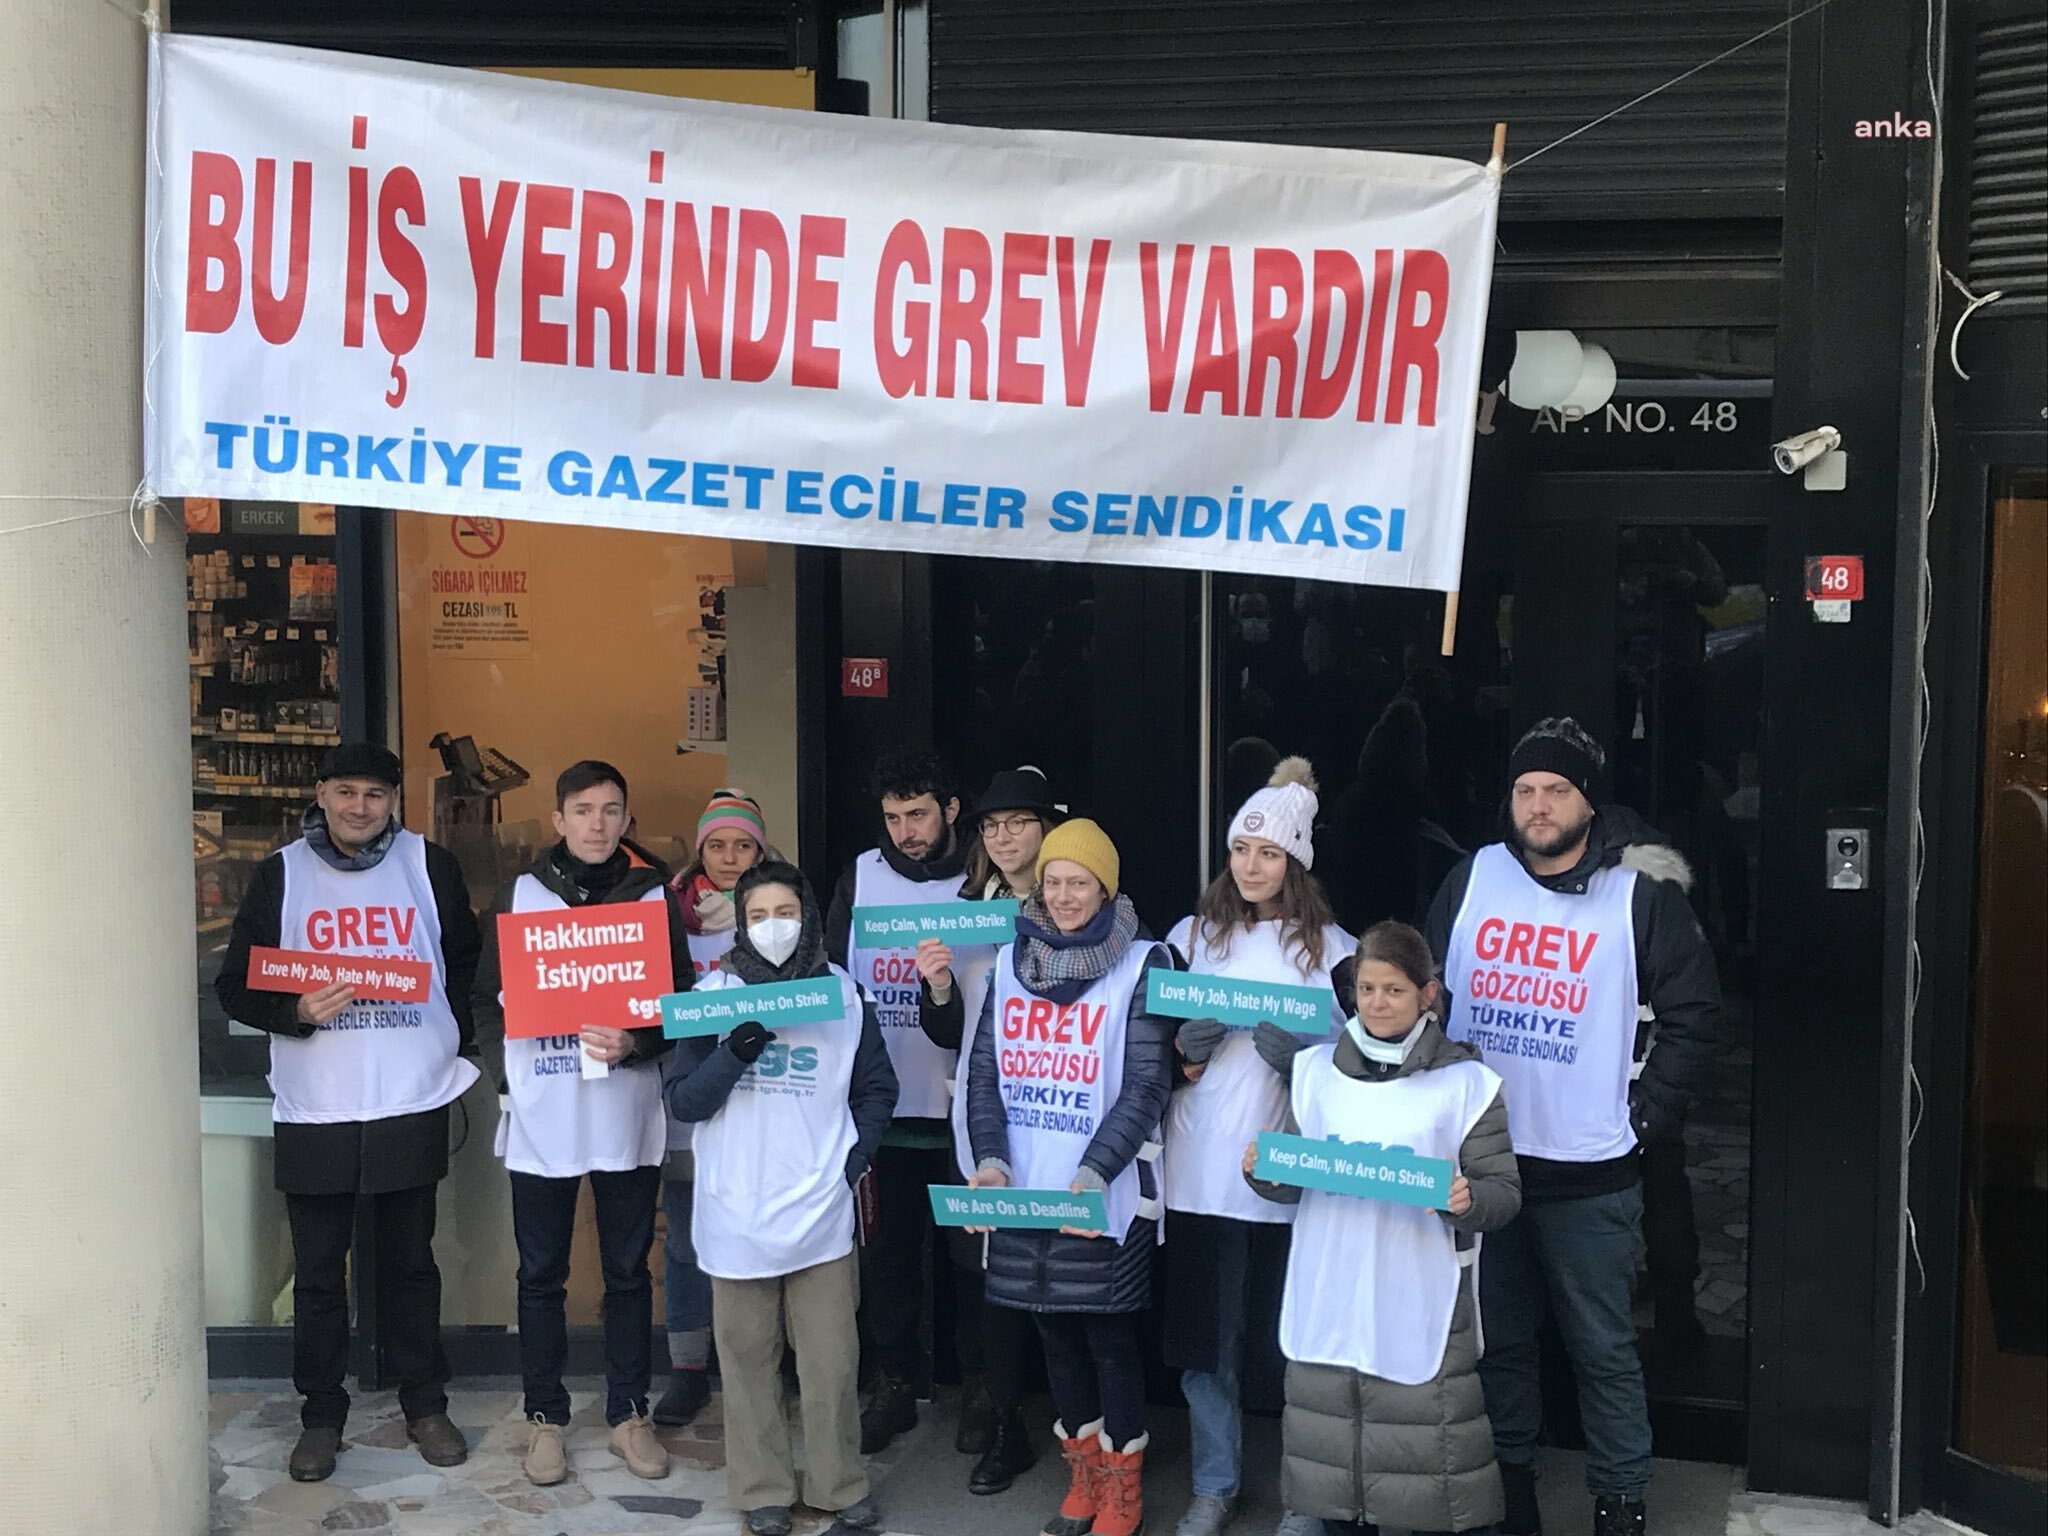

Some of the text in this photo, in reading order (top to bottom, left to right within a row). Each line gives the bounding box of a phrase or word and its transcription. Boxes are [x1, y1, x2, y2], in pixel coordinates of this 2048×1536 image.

[185, 115, 1450, 427] BU İŞ YERİNDE GREV VARDIR
[1530, 404, 1590, 434] AP.
[1605, 402, 1675, 433] NO.
[1690, 401, 1738, 432] 48
[204, 414, 1406, 552] TÜRKİYE GAZETECİLER SENDİKASI
[240, 510, 285, 525] ERKEK
[432, 563, 528, 597] SİGARA İÇİLMEZ
[1821, 566, 1849, 591] 48
[442, 601, 485, 618] CEZASI
[504, 601, 519, 618] TL
[306, 905, 417, 951] GREV
[524, 921, 645, 952] Hakkımızı
[864, 913, 1007, 935] Keep Calm, We Are On Strike
[1475, 917, 1600, 975] GREV
[261, 959, 417, 993] Love My Job, Hate My Wage
[535, 957, 648, 992] İstiyoruz
[1470, 964, 1589, 1014] GÖZCÜSÜ
[673, 992, 829, 1022] Keep Calm, We Are On Strike
[1159, 982, 1317, 1020] Love My Job, Hate My Wage
[374, 1008, 422, 1029] SENDİKASI
[1003, 997, 1107, 1046] GREV
[1470, 1003, 1577, 1039] TÜRKİYE
[1001, 1043, 1101, 1085] GÖZCÜSÜ
[1521, 1035, 1580, 1066] SENDİKASI
[1003, 1081, 1091, 1110] TÜRKİYE
[1042, 1108, 1095, 1137] SENDİKASI
[1268, 1147, 1435, 1189] Keep Calm, We Are On Strike
[945, 1197, 1091, 1218] We Are On a Deadline
